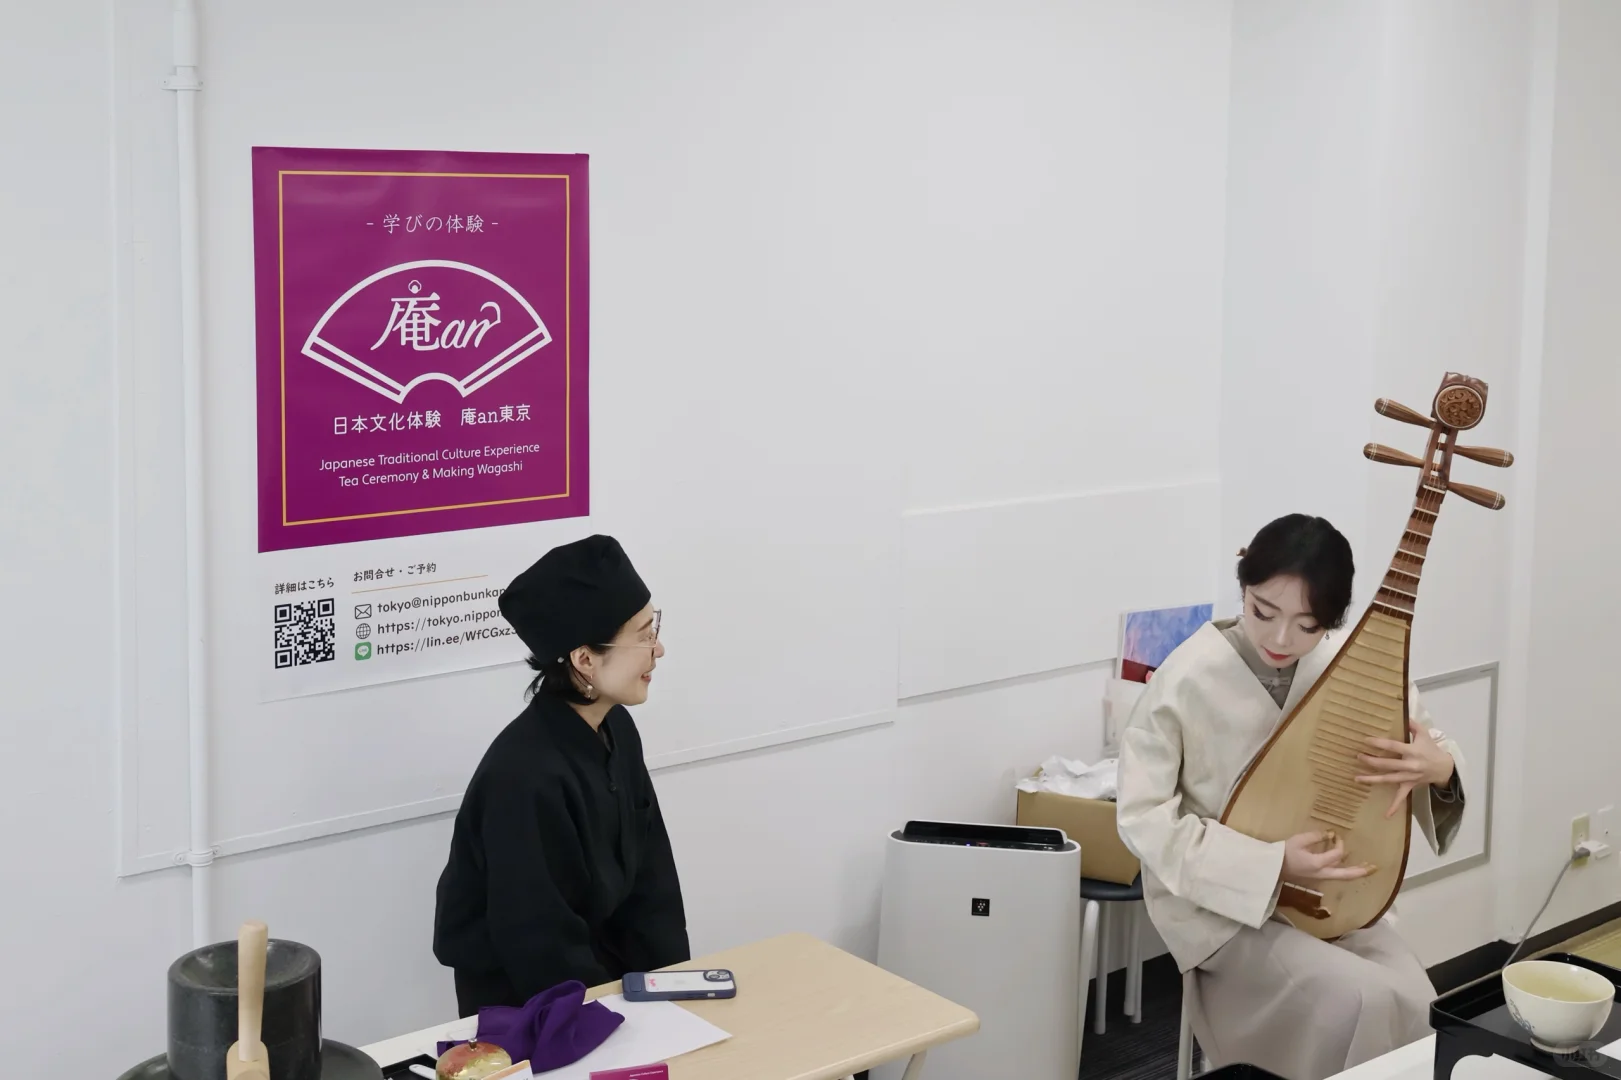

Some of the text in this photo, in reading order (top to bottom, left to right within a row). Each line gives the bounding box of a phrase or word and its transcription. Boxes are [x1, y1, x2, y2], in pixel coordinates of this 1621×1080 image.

[383, 213, 485, 234] 学びの体験
[333, 404, 531, 435] 日本文化体験 庵an東京
[319, 443, 540, 472] Japanese Traditional Culture Experience
[338, 460, 523, 487] Tea Ceremony & Making Wagashi
[353, 562, 437, 582] お問合せ・ご予約
[274, 577, 335, 595] 詳細はこちら
